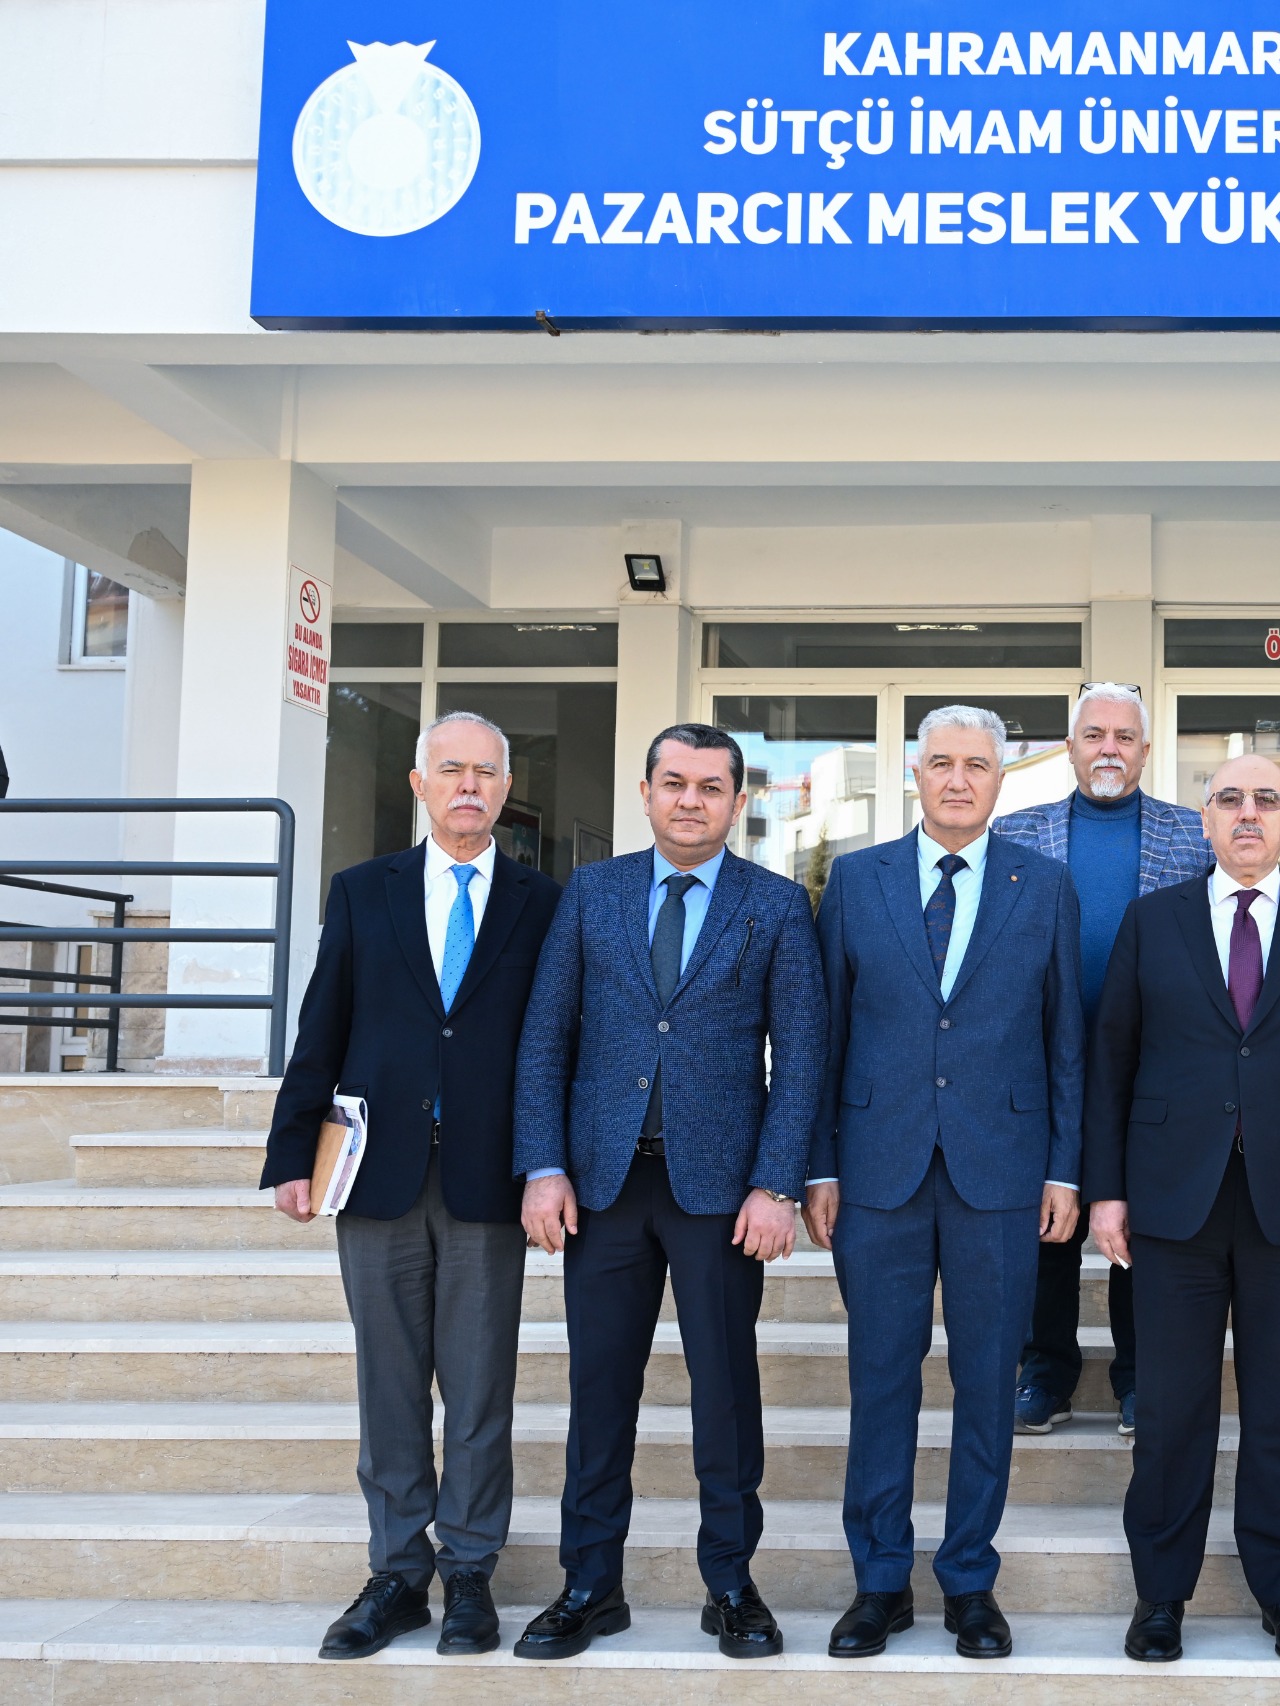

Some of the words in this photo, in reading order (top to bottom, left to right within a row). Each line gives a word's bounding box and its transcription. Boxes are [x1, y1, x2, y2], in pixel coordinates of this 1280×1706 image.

[703, 97, 894, 170] SÜTÇÜ
[909, 96, 1062, 154] İMAM
[514, 192, 854, 245] PAZARCIK
[868, 192, 1140, 245] MESLEK
[295, 623, 302, 641] BU
[303, 628, 322, 650] ALANDA
[288, 642, 308, 678] SİGARA
[310, 650, 327, 685] İÇMEK
[292, 679, 321, 705] YASAKTIR
